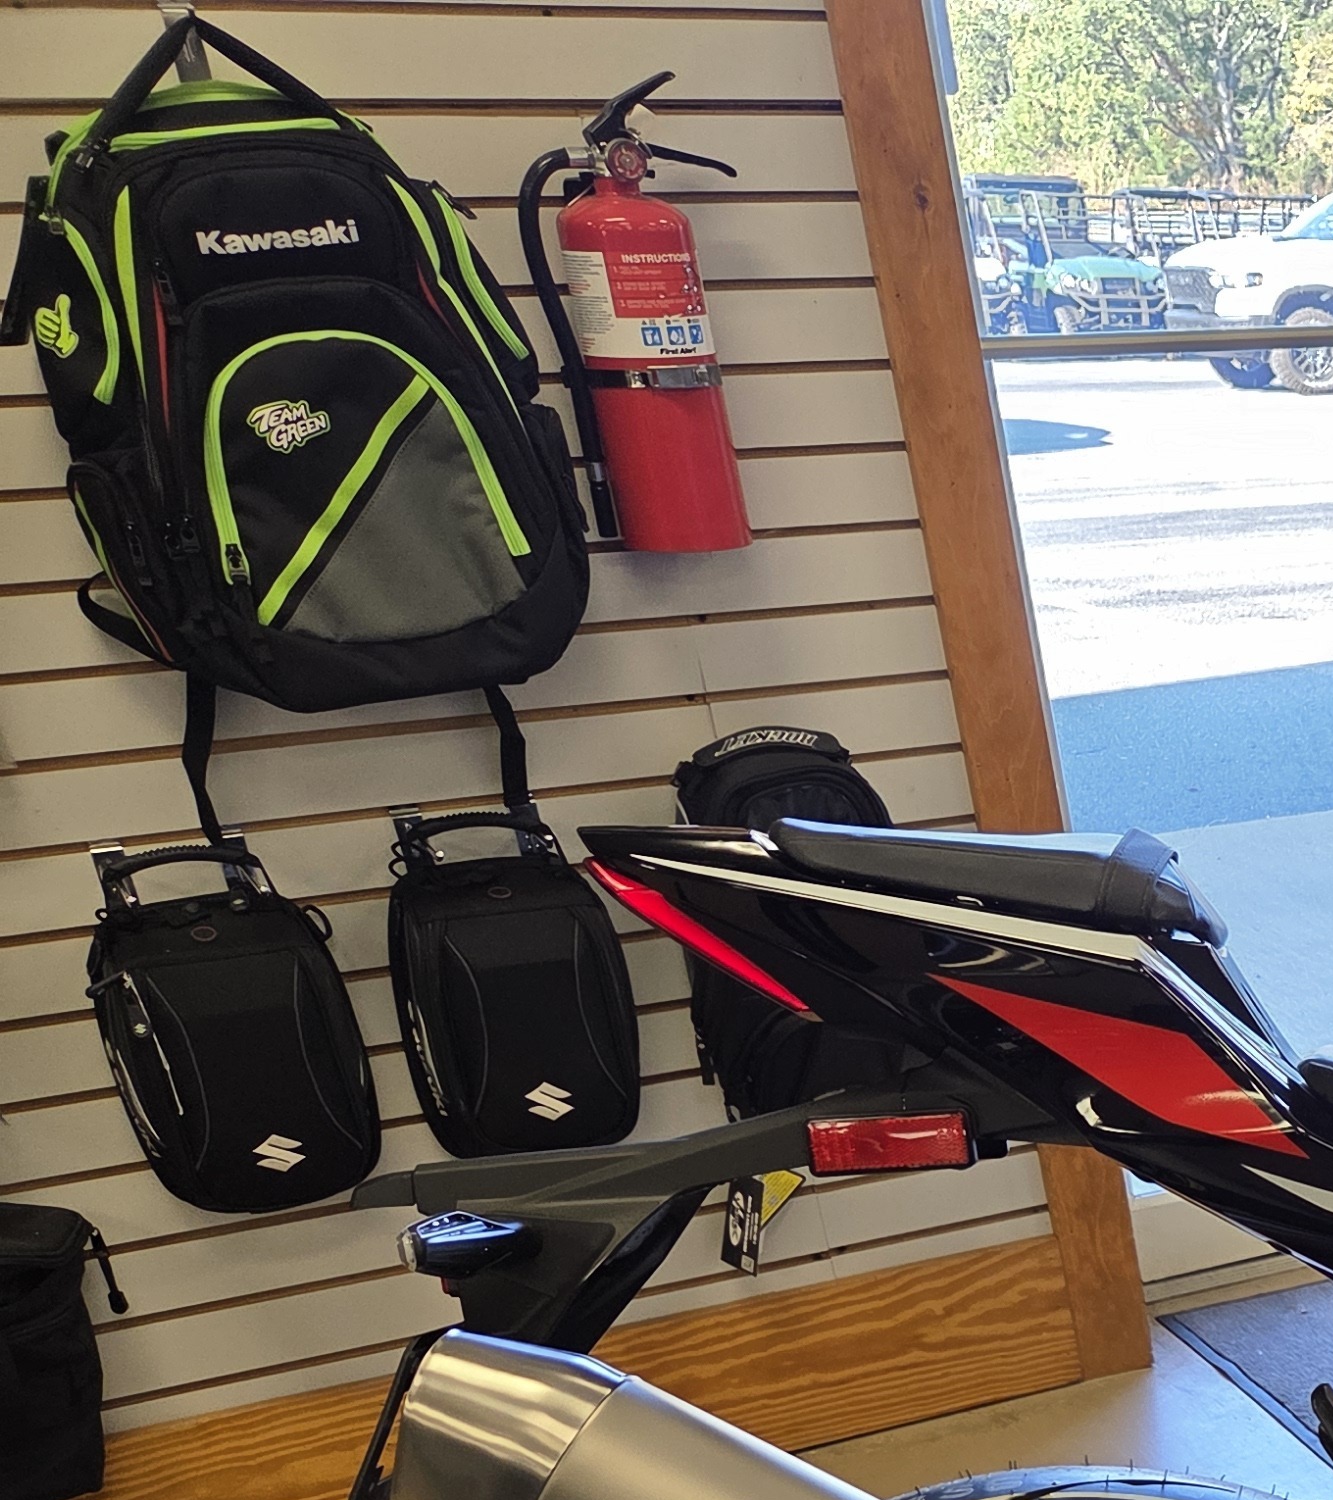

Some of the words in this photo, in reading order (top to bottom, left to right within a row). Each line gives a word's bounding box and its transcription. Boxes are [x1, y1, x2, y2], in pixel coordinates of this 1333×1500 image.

[196, 219, 360, 255] Kawasaki
[251, 403, 308, 432] TEAM
[269, 415, 327, 449] GREEN
[714, 729, 818, 757] ROCKET
